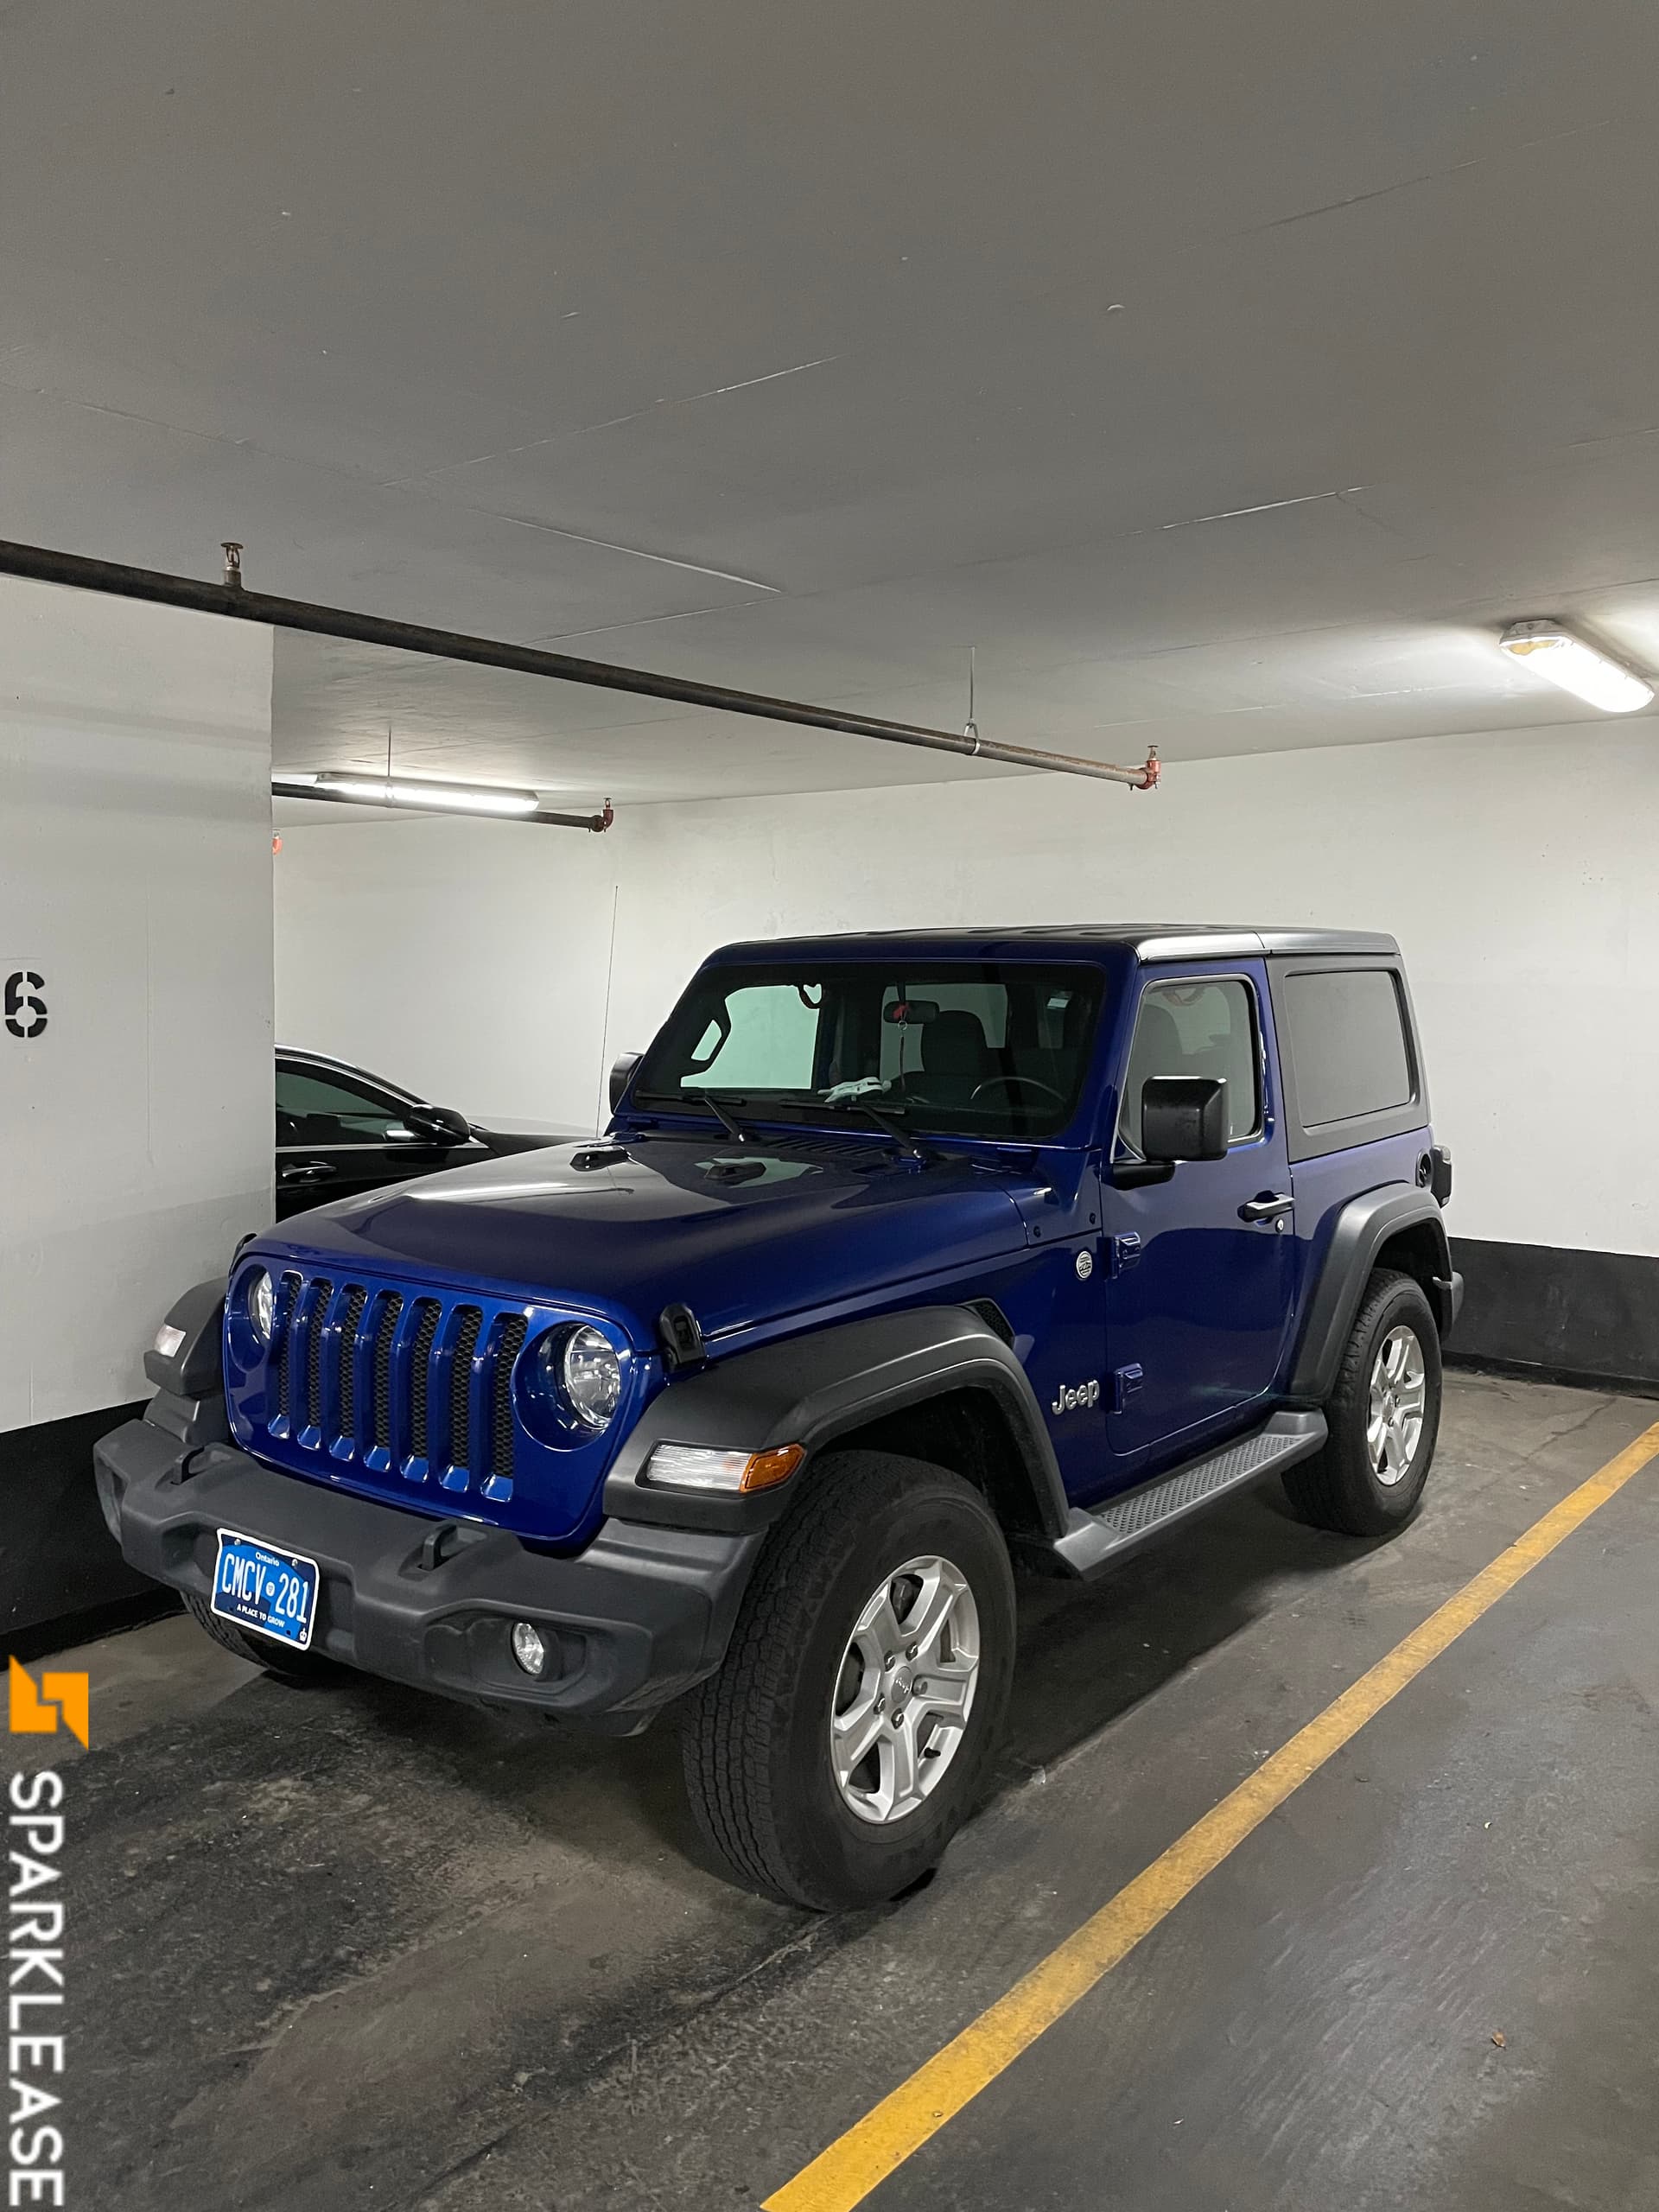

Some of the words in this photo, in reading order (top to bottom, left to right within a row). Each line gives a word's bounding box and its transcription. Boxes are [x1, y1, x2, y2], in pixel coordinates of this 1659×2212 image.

[4, 970, 48, 1039] 6
[1052, 1380, 1100, 1415] Jeep
[255, 1551, 280, 1567] Ontario
[222, 1553, 267, 1605] CMCV
[275, 1573, 308, 1624] 281
[242, 1605, 258, 1618] PLACE
[259, 1611, 267, 1621] TO
[267, 1615, 285, 1628] GROW
